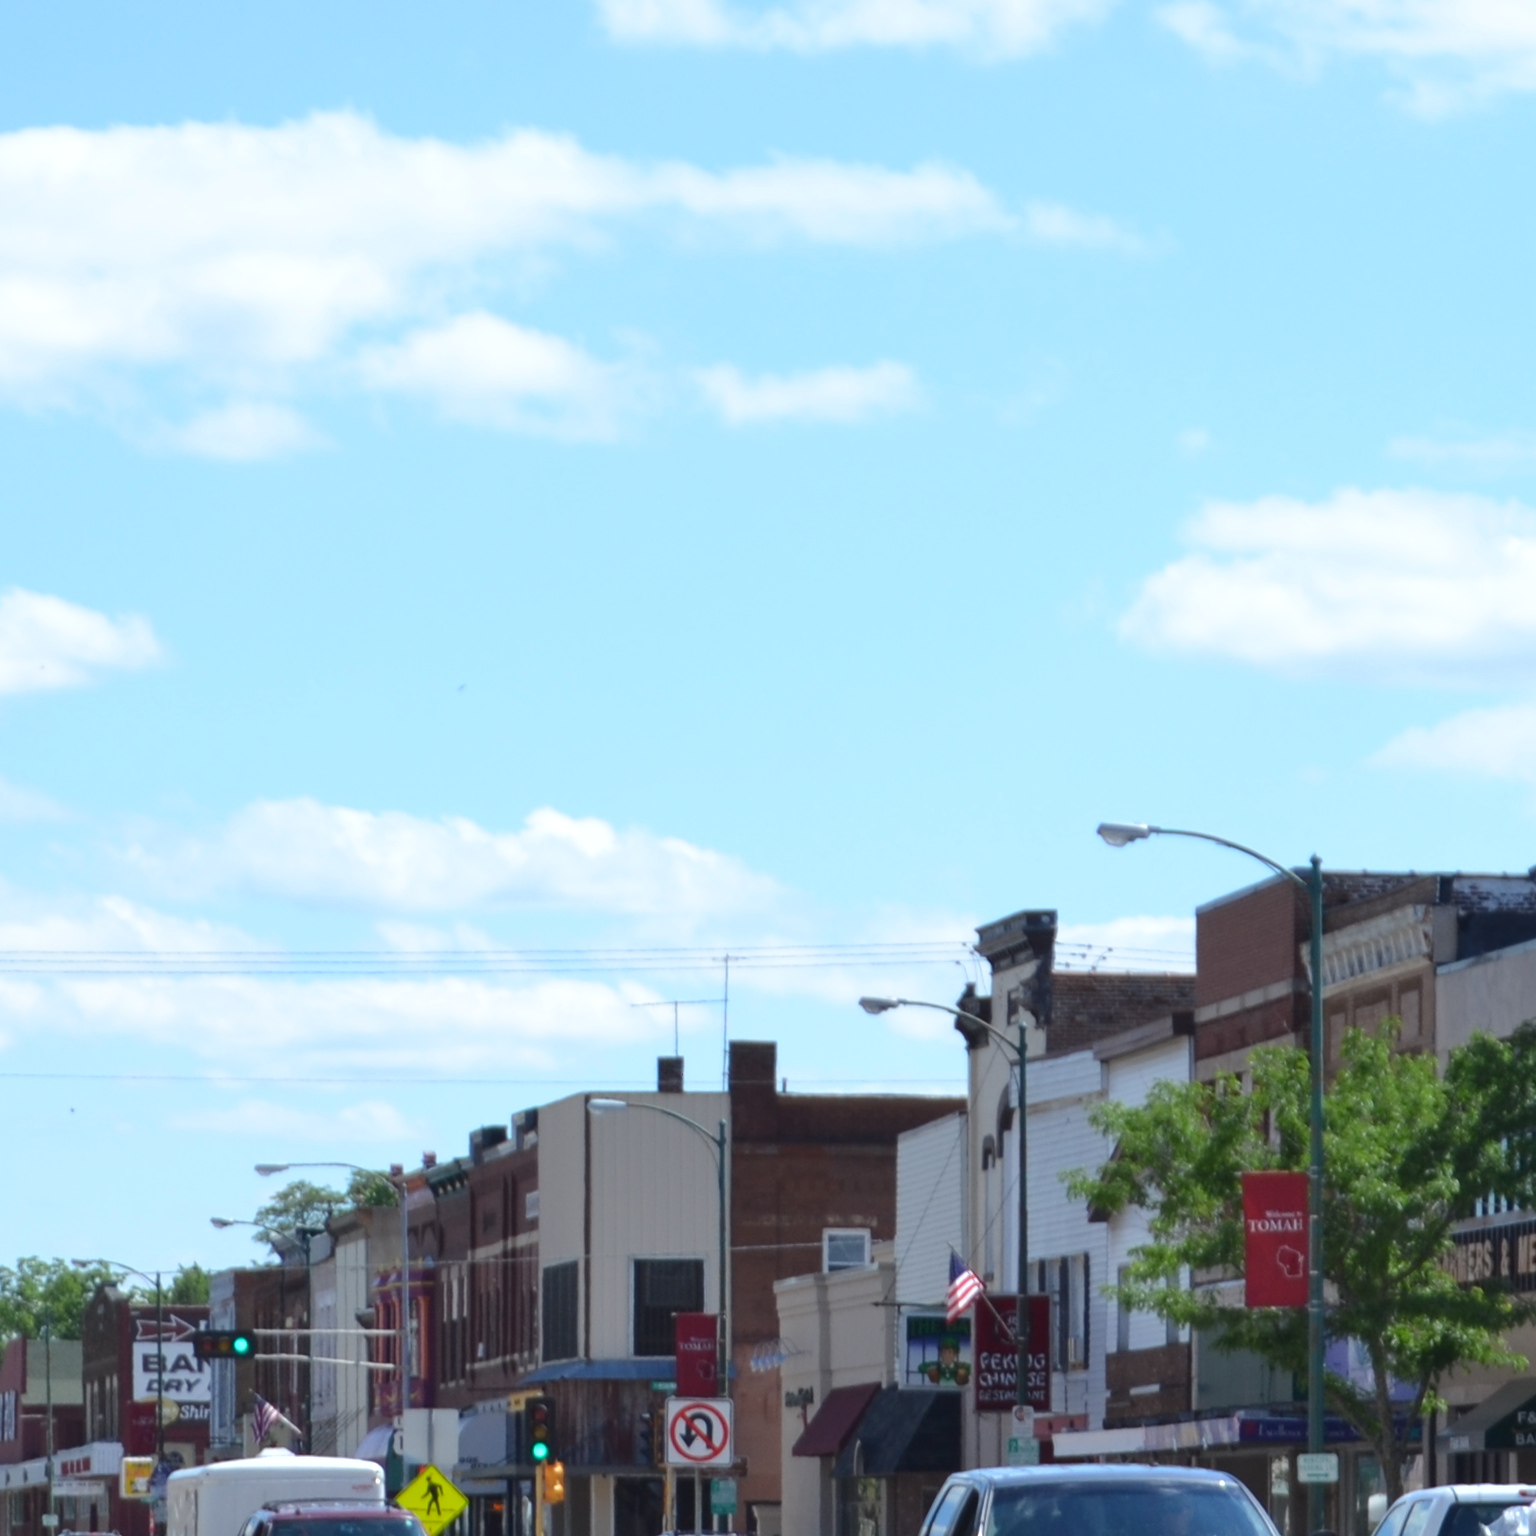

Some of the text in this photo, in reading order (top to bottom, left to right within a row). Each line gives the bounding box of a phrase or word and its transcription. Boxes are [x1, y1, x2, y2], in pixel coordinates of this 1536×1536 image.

[1249, 1219, 1303, 1232] TOMAH
[1500, 1237, 1511, 1277] &
[980, 1352, 1046, 1370] PEKIG
[979, 1372, 1046, 1387] CHINSE
